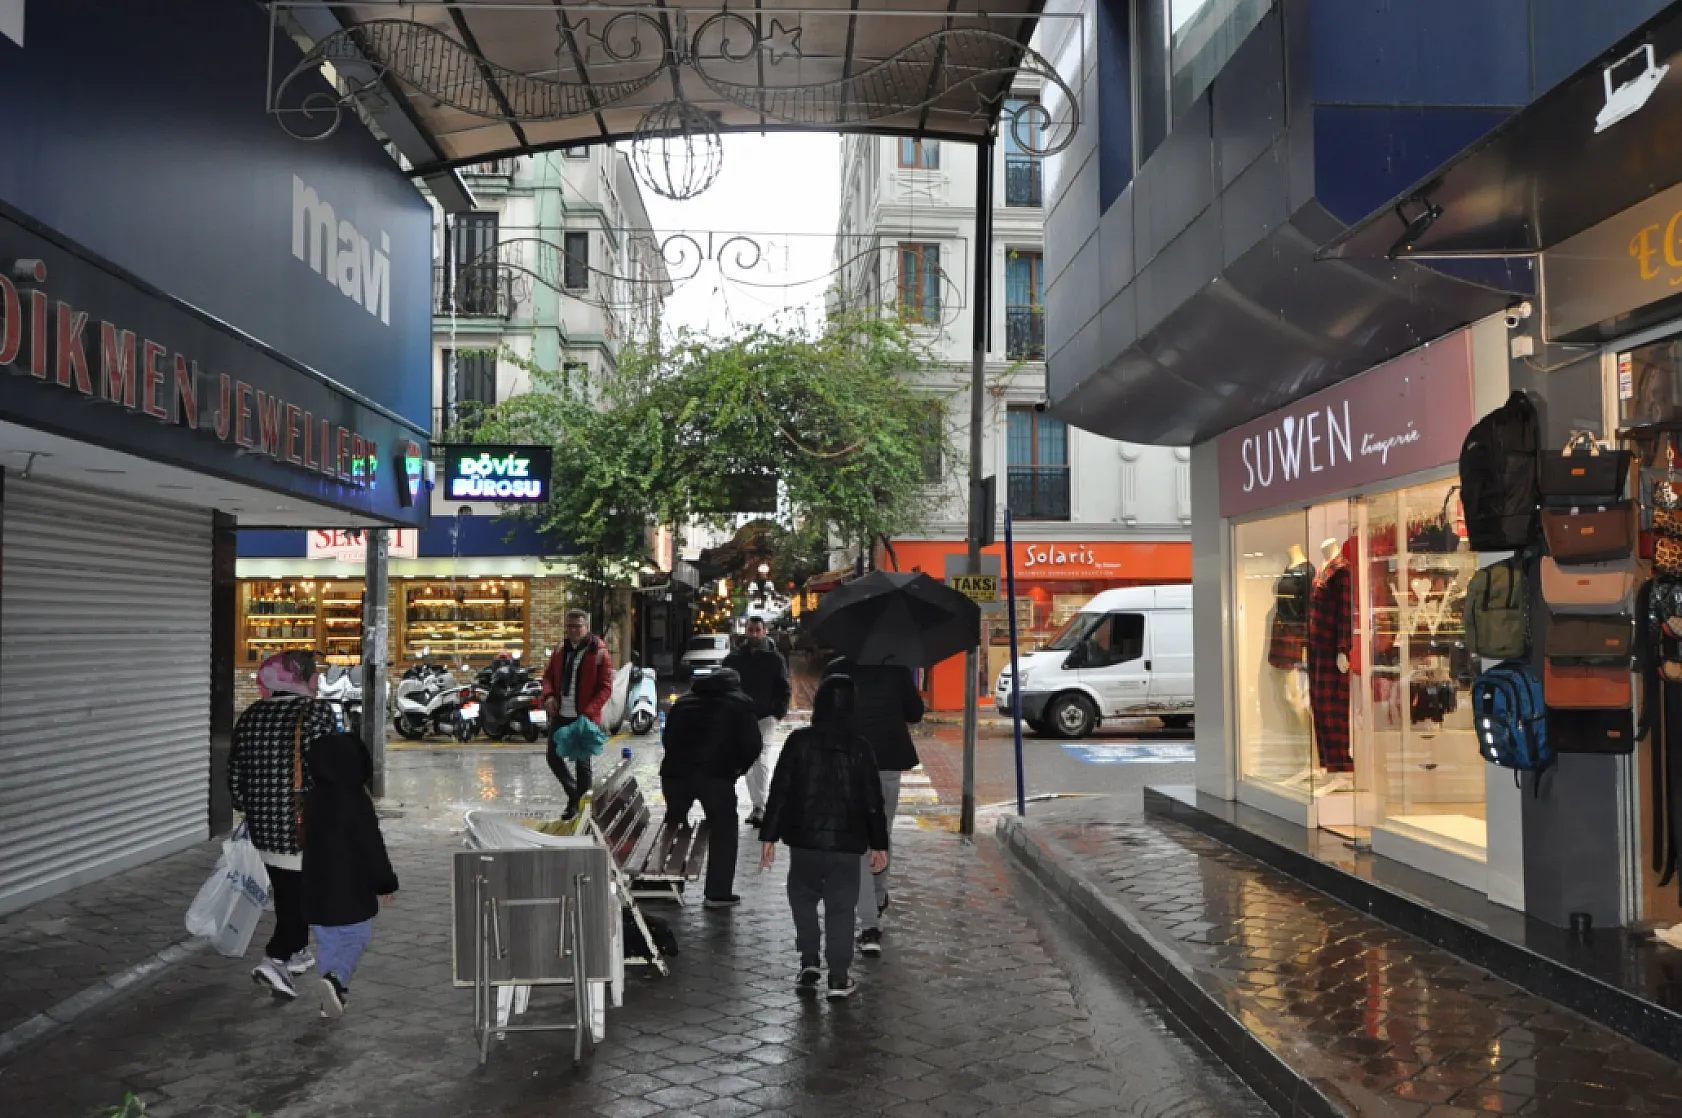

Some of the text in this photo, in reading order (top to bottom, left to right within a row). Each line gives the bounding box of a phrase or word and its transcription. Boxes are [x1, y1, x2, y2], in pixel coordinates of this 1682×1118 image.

[292, 172, 391, 327] mavi
[1242, 400, 1421, 492] SUWEN lingerie
[460, 453, 530, 477] DÖVİZ
[453, 474, 541, 498] BÜROSU
[1024, 544, 1095, 567] Solaris
